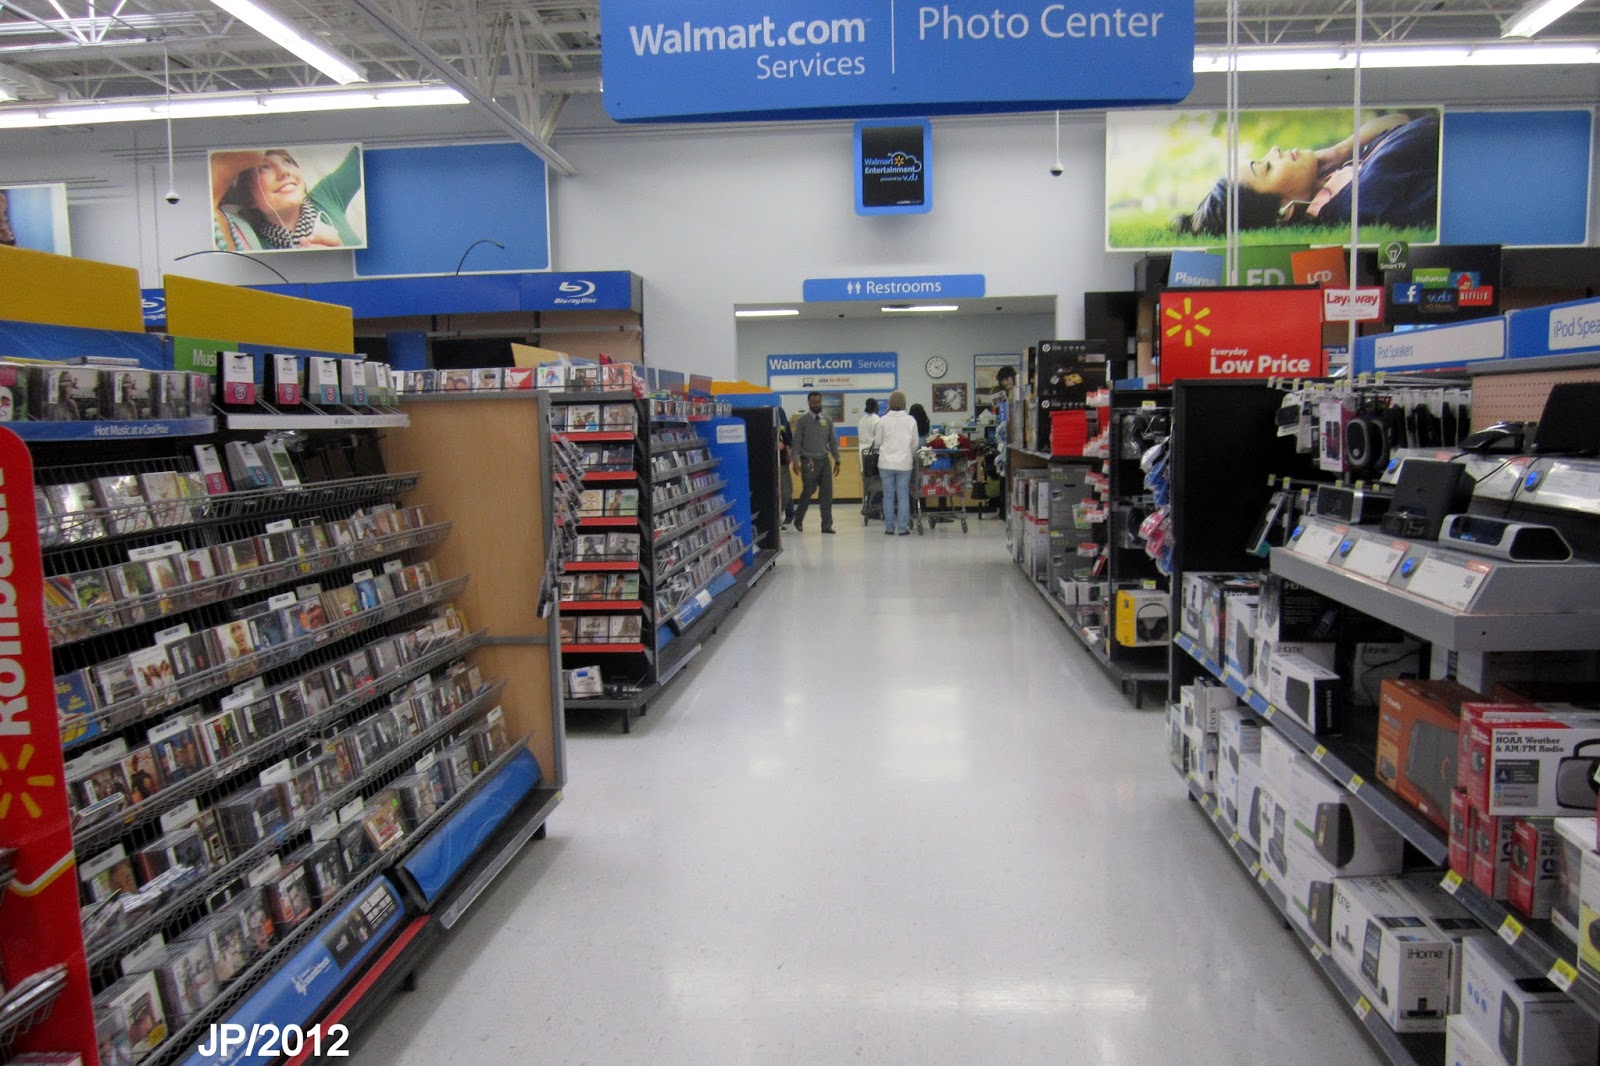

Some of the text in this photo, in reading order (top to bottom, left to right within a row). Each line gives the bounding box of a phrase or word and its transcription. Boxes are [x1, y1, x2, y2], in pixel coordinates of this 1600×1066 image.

[919, 4, 1165, 41] Photo Center
[630, 17, 866, 56] Walmart.com
[756, 53, 866, 80] Services
[864, 157, 894, 166] Walmart
[864, 165, 916, 175] Entertainment
[1175, 271, 1216, 285] Plasma
[1307, 270, 1332, 284] LCD
[866, 280, 941, 295] Restrooms
[1460, 292, 1488, 301] NETFLIX
[1554, 319, 1575, 338] iPod
[192, 349, 217, 367] Musi
[1210, 348, 1248, 358] Everyday
[769, 358, 896, 370] Walmart.com Services
[1210, 354, 1311, 374] Low Price
[95, 425, 109, 436] Hot
[110, 424, 130, 435] Music
[1496, 736, 1560, 744] NOAA Weather
[1406, 948, 1443, 959] iHome
